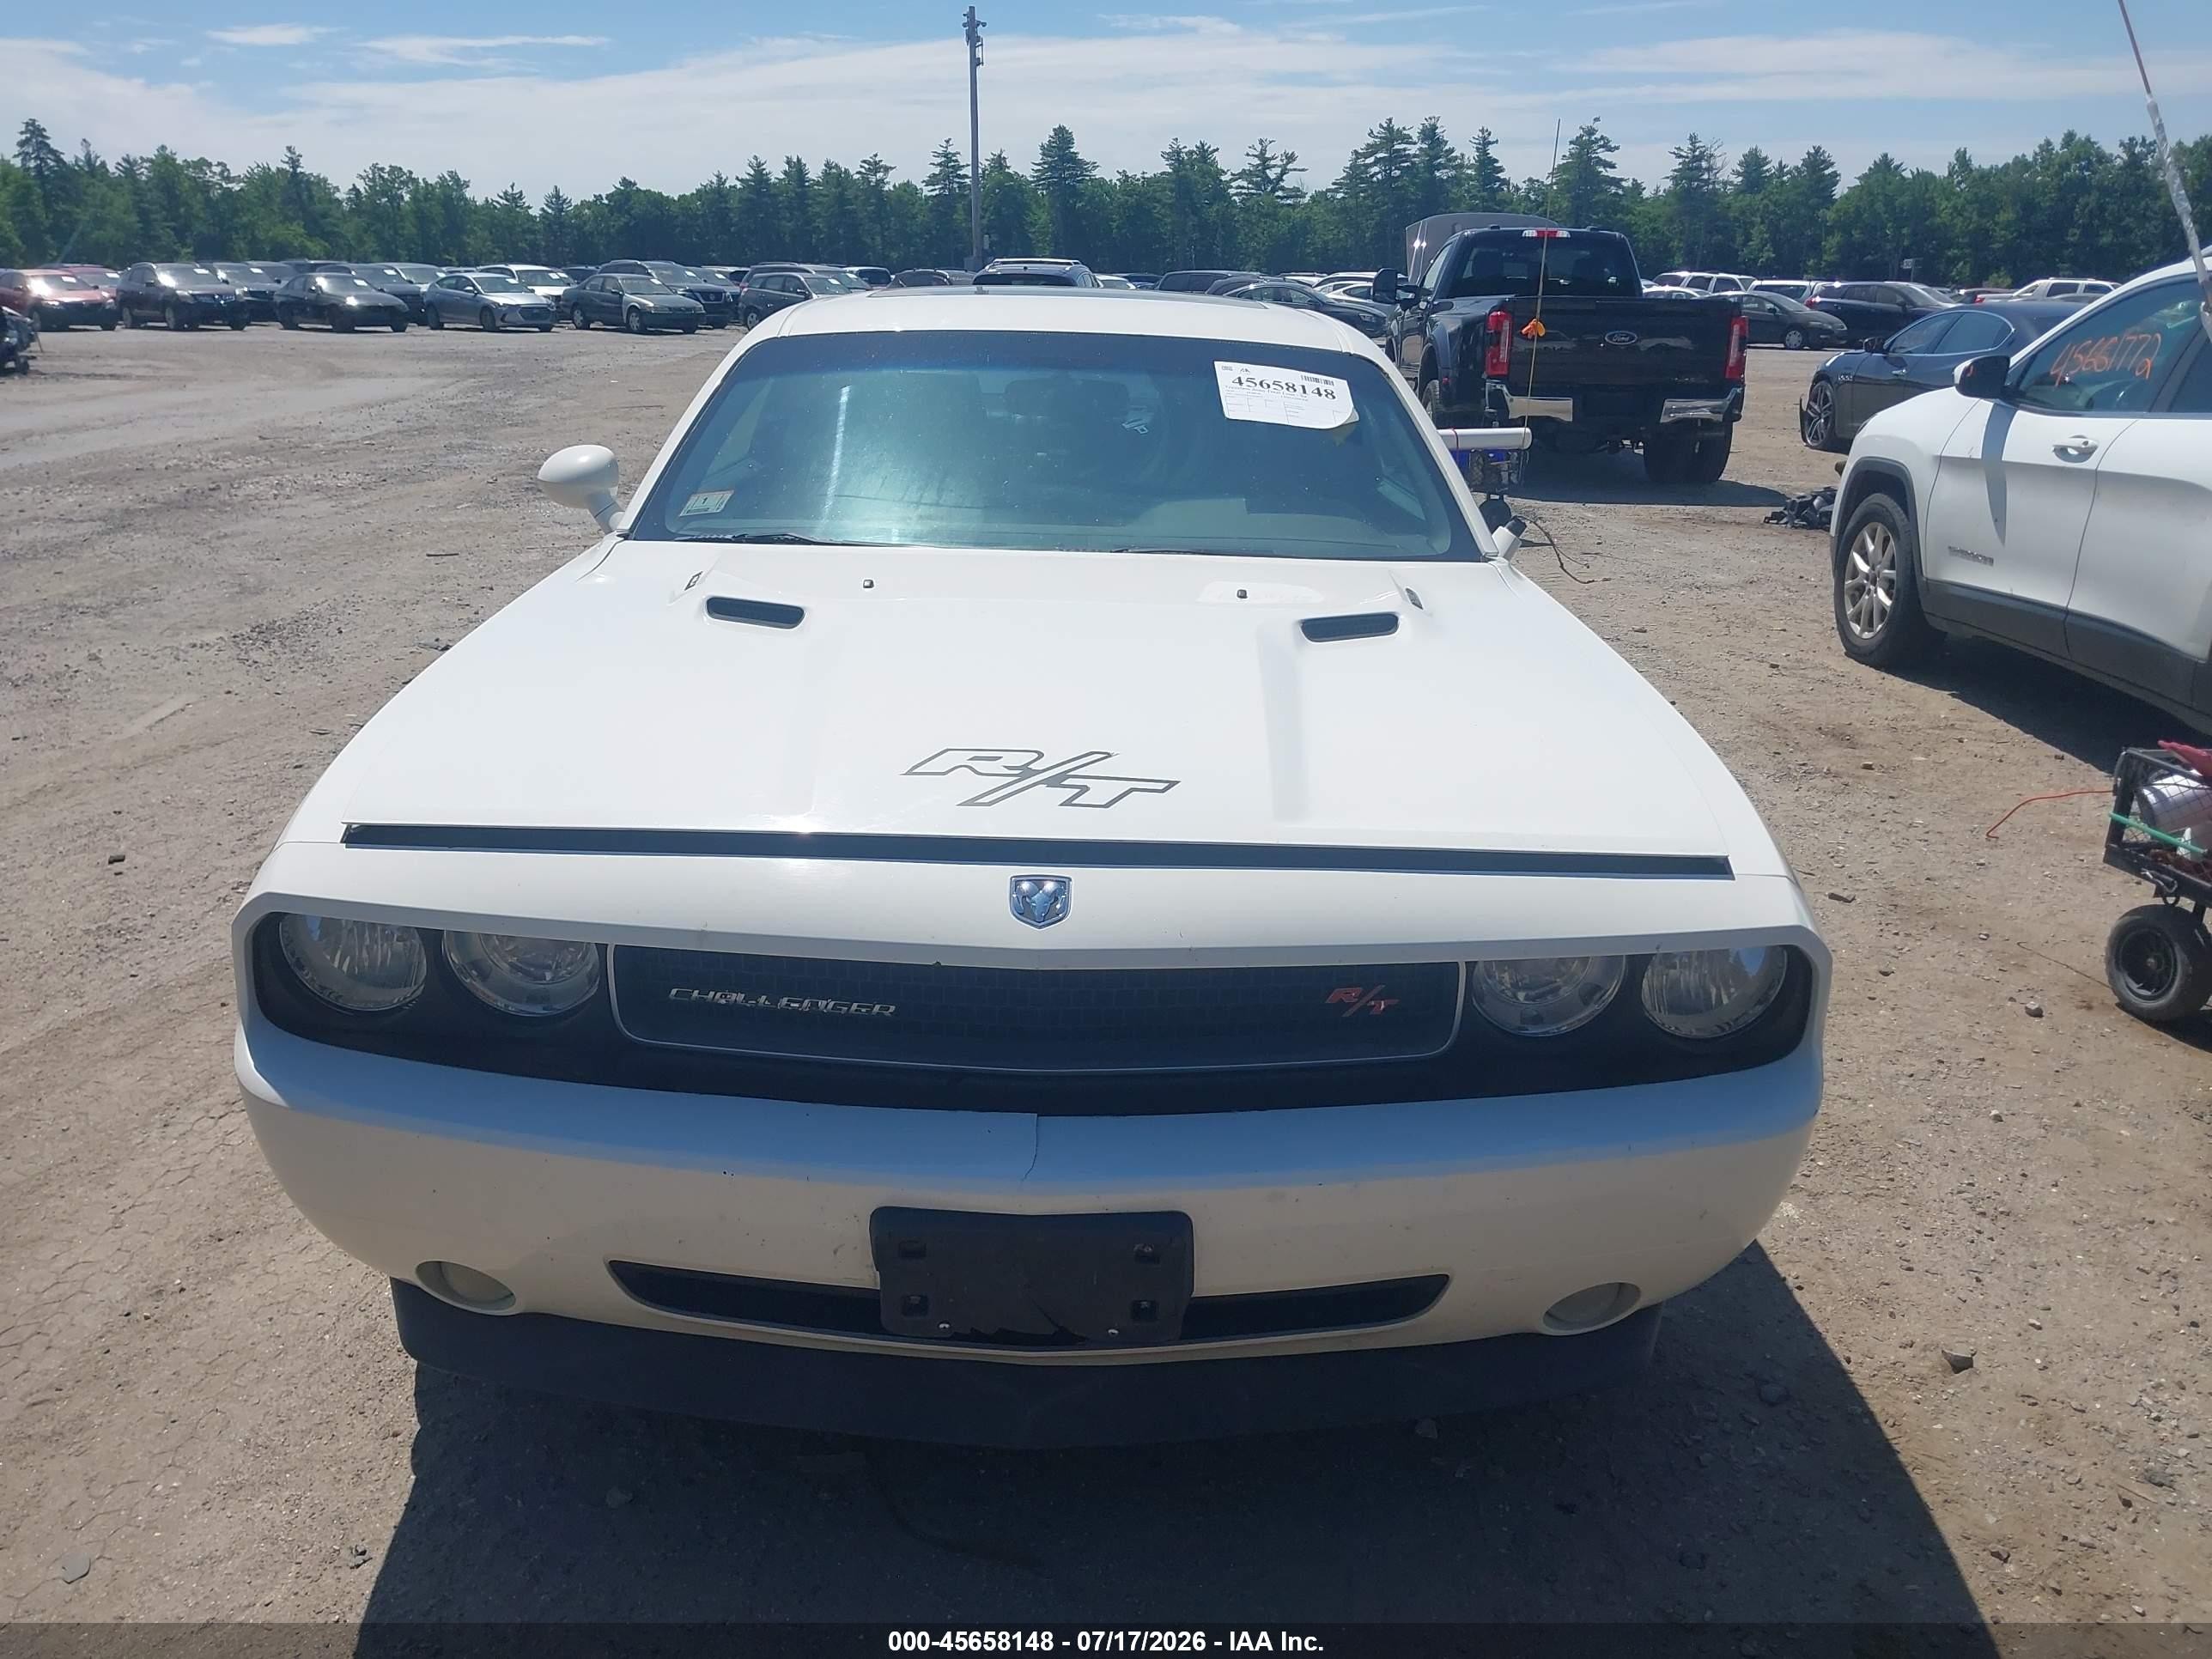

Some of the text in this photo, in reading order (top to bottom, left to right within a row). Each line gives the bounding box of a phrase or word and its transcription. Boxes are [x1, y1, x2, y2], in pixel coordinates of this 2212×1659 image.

[1231, 376, 1337, 400] 45658148
[901, 748, 1182, 808] R/T
[668, 987, 896, 1018] CHALLENGER
[1325, 985, 1400, 1017] R/T
